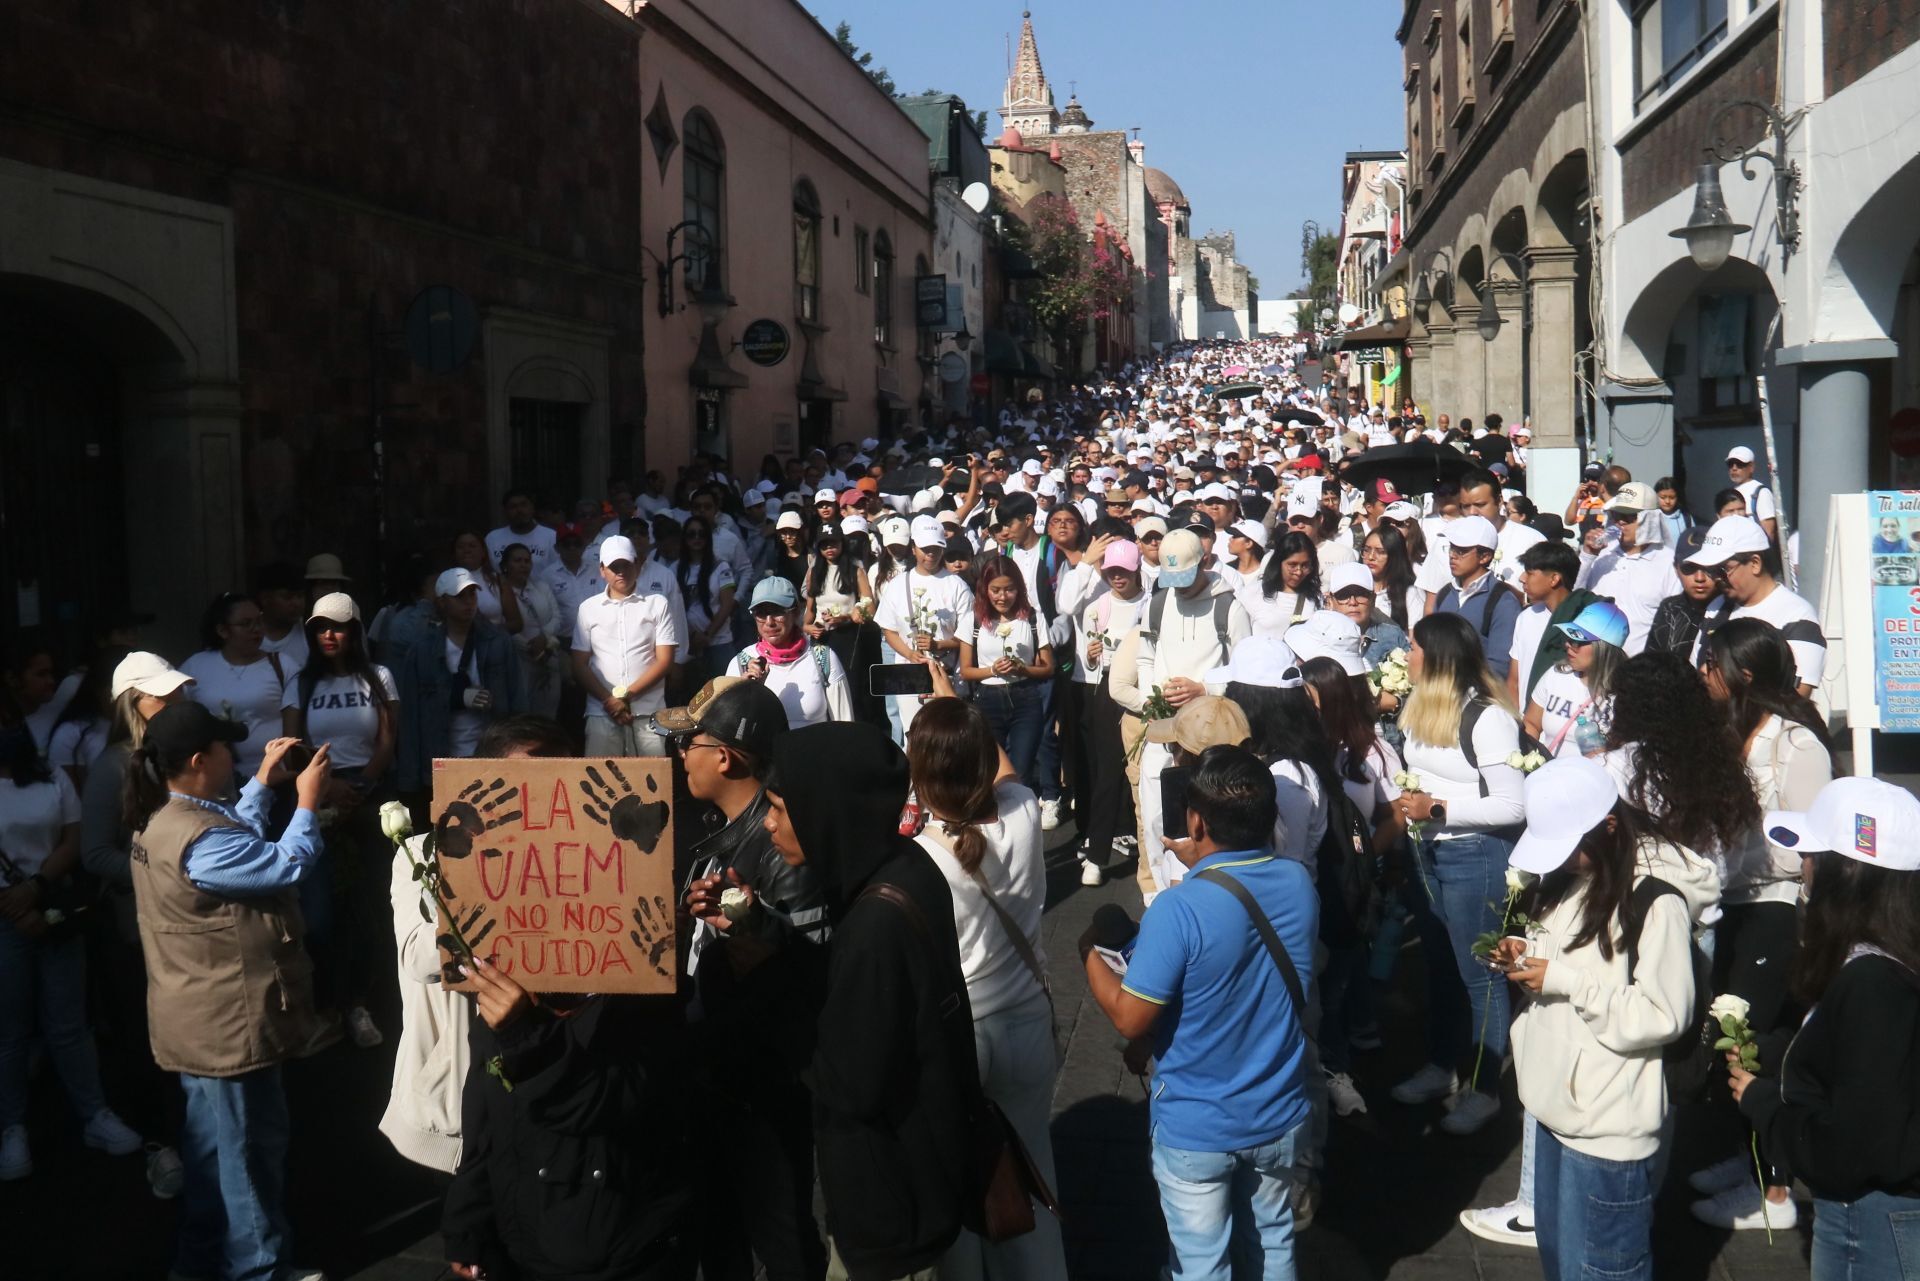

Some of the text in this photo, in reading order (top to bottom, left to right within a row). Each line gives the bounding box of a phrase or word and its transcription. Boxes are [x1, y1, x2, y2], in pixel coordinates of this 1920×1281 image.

[519, 778, 575, 831] LA
[477, 840, 626, 902] UAEM
[505, 901, 624, 934] NO NOS
[490, 935, 633, 977] CUIDA
